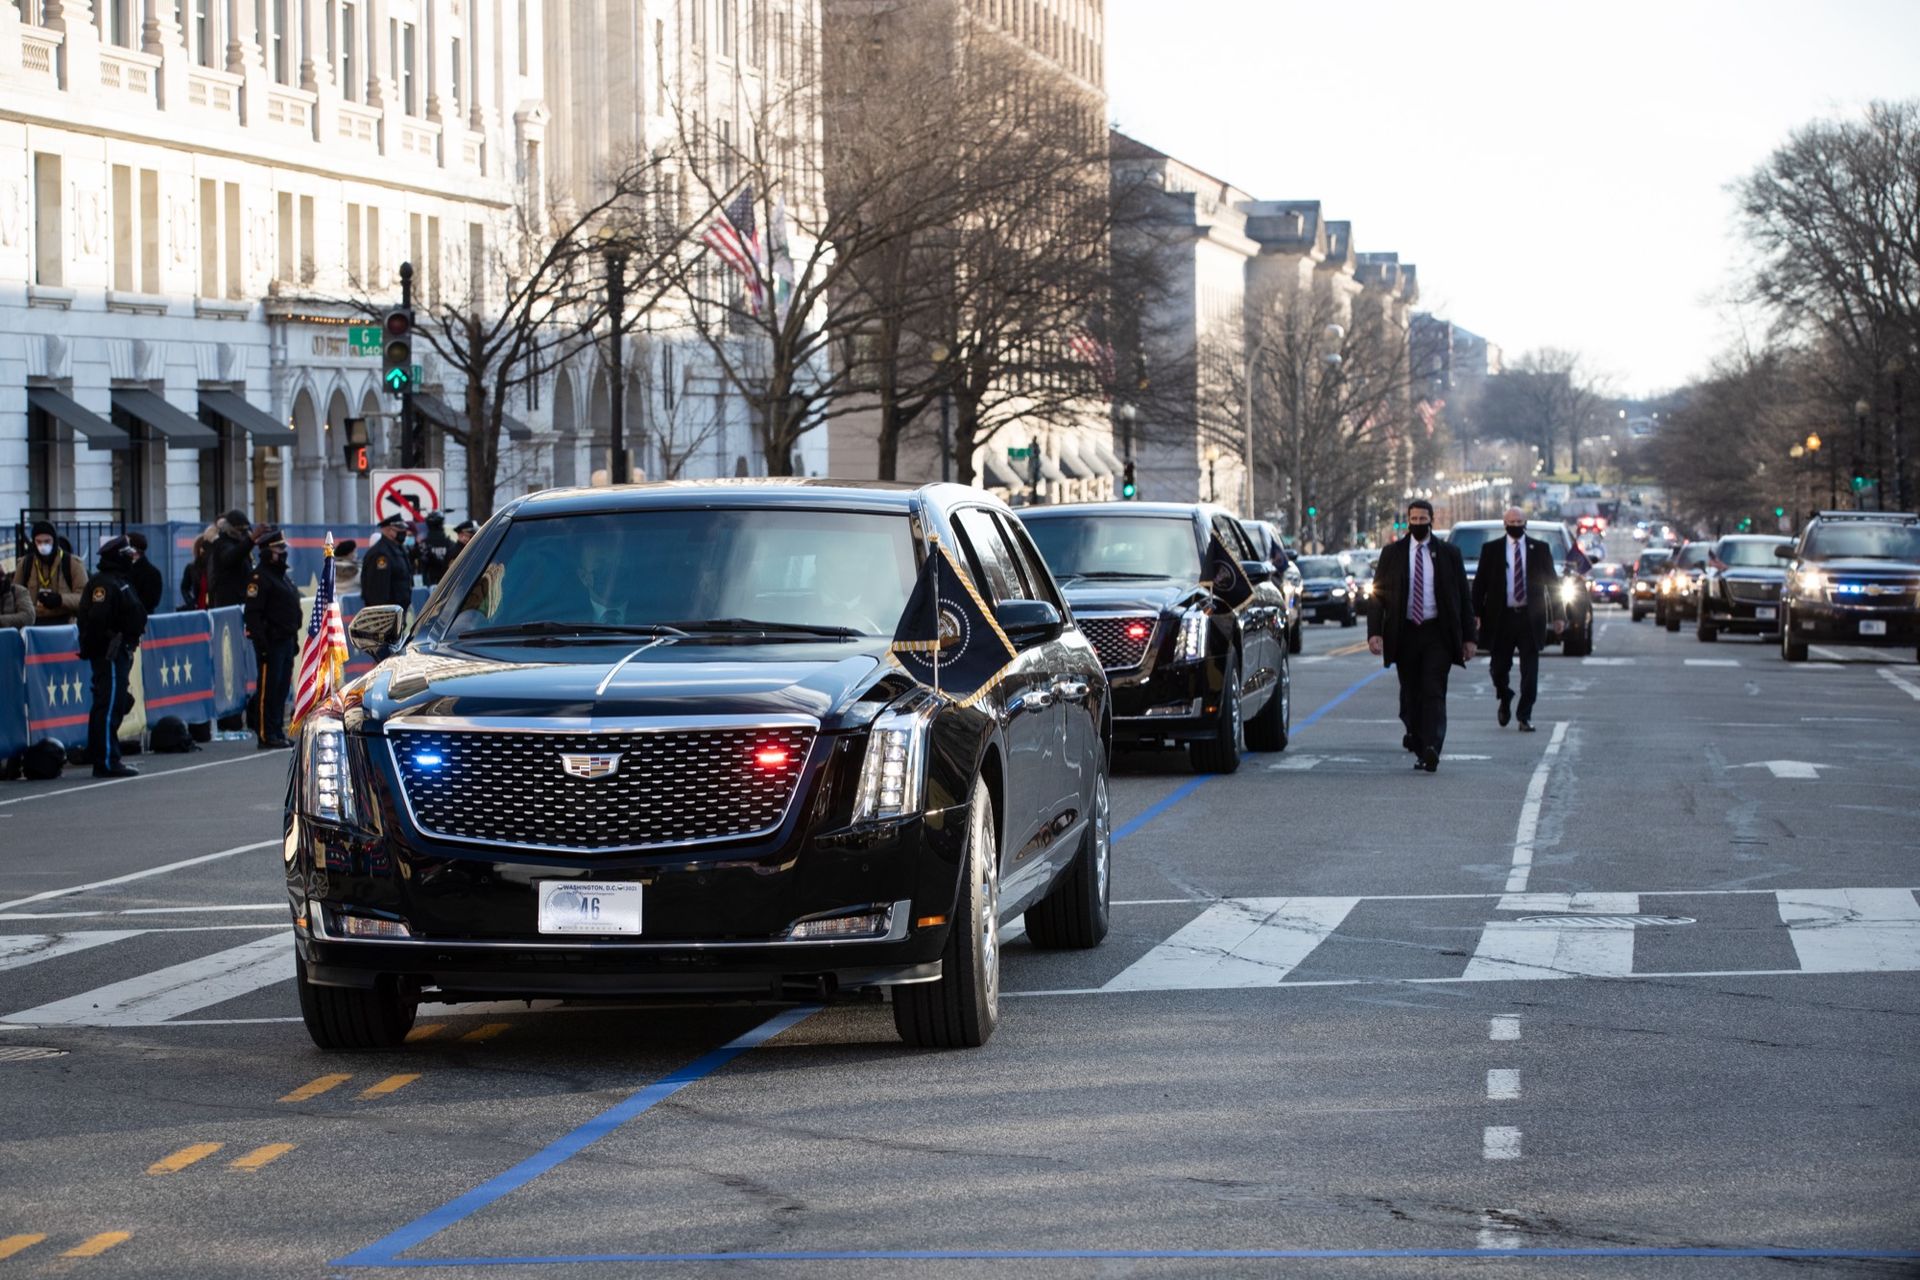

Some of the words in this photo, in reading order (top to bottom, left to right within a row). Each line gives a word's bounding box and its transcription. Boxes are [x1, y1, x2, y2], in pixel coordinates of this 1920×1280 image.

[362, 329, 370, 344] G
[362, 346, 382, 356] 140
[358, 447, 368, 469] 6
[581, 897, 600, 920] 46
